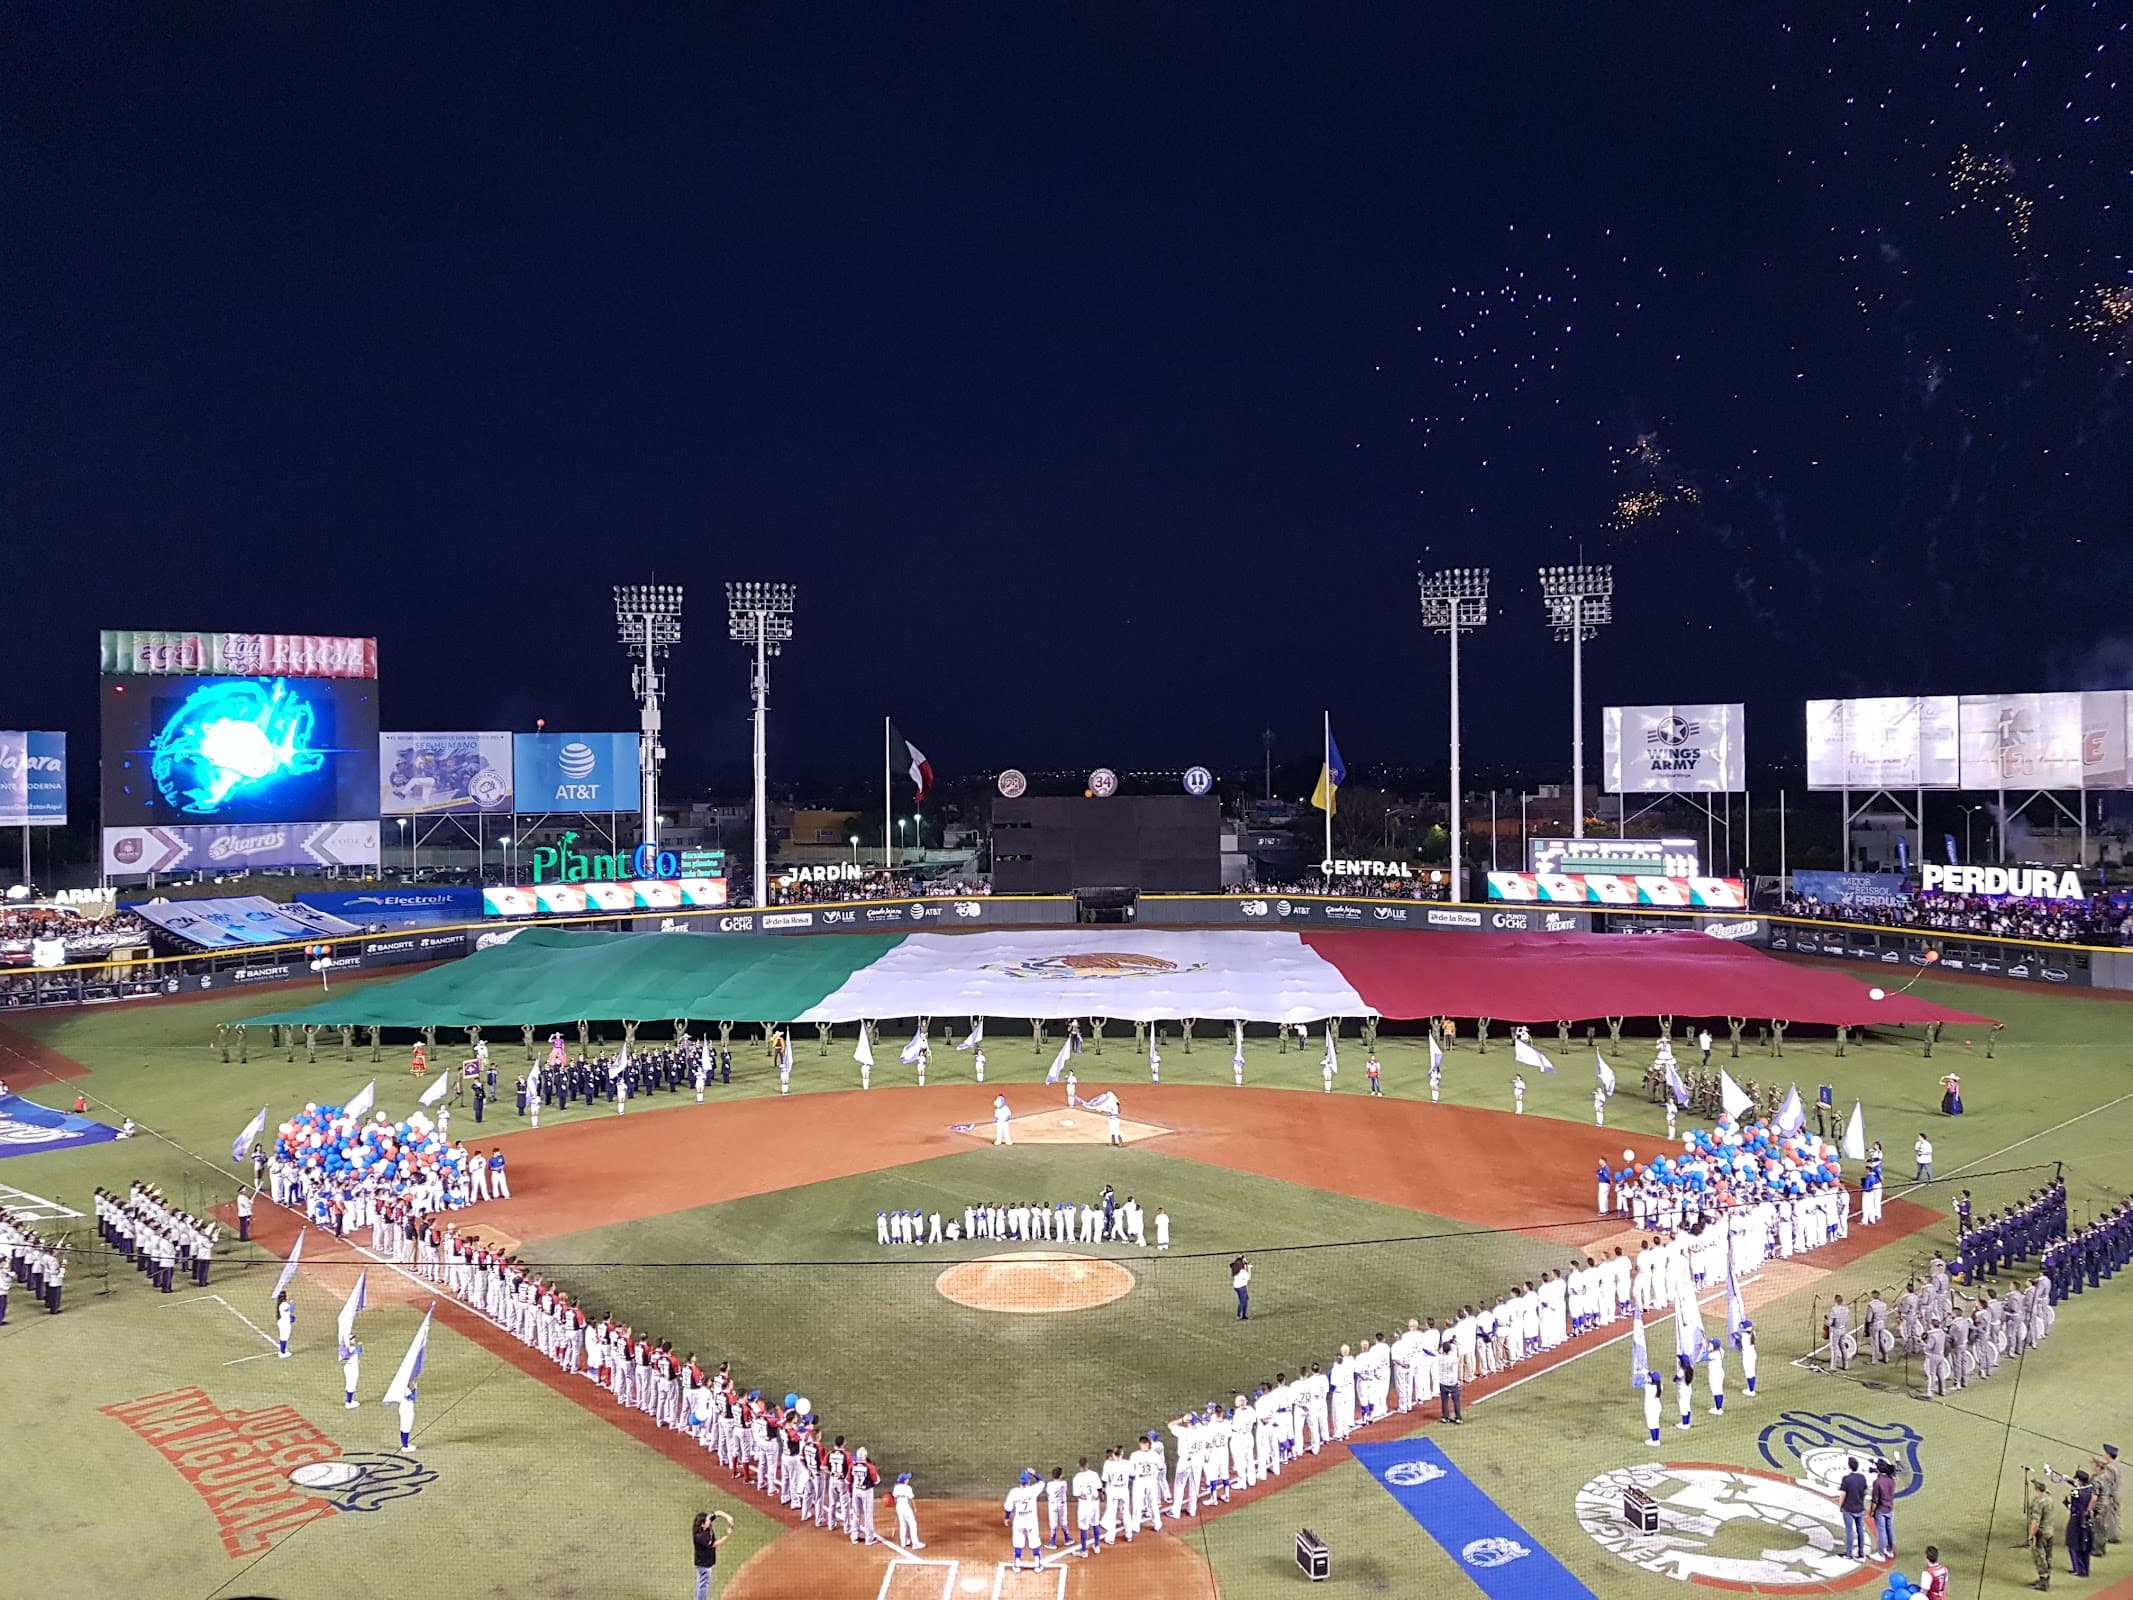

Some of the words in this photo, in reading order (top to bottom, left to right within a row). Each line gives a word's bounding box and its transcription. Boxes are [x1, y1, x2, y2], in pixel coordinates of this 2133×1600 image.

[1651, 760, 1697, 770] ARMY
[1095, 776, 1111, 788] 34
[1191, 773, 1205, 785] 11
[555, 784, 600, 800] AT&T
[208, 832, 286, 860] Charros
[787, 861, 860, 882] JARDÍN
[1321, 860, 1412, 878] CENTRAL
[1922, 865, 2085, 900] PERDURA
[55, 887, 117, 904] ARMY
[1855, 886, 1892, 895] BEISBOL
[384, 895, 453, 906] Electrolit
[1855, 895, 1905, 907] PERDU
[1457, 915, 1477, 923] Rosa
[1506, 920, 1527, 929] CHG
[733, 922, 753, 931] CHG
[377, 941, 414, 951] BANORTE
[430, 936, 465, 946] BANORTE
[327, 957, 361, 968] ANORTE
[247, 967, 289, 977] BANORTE
